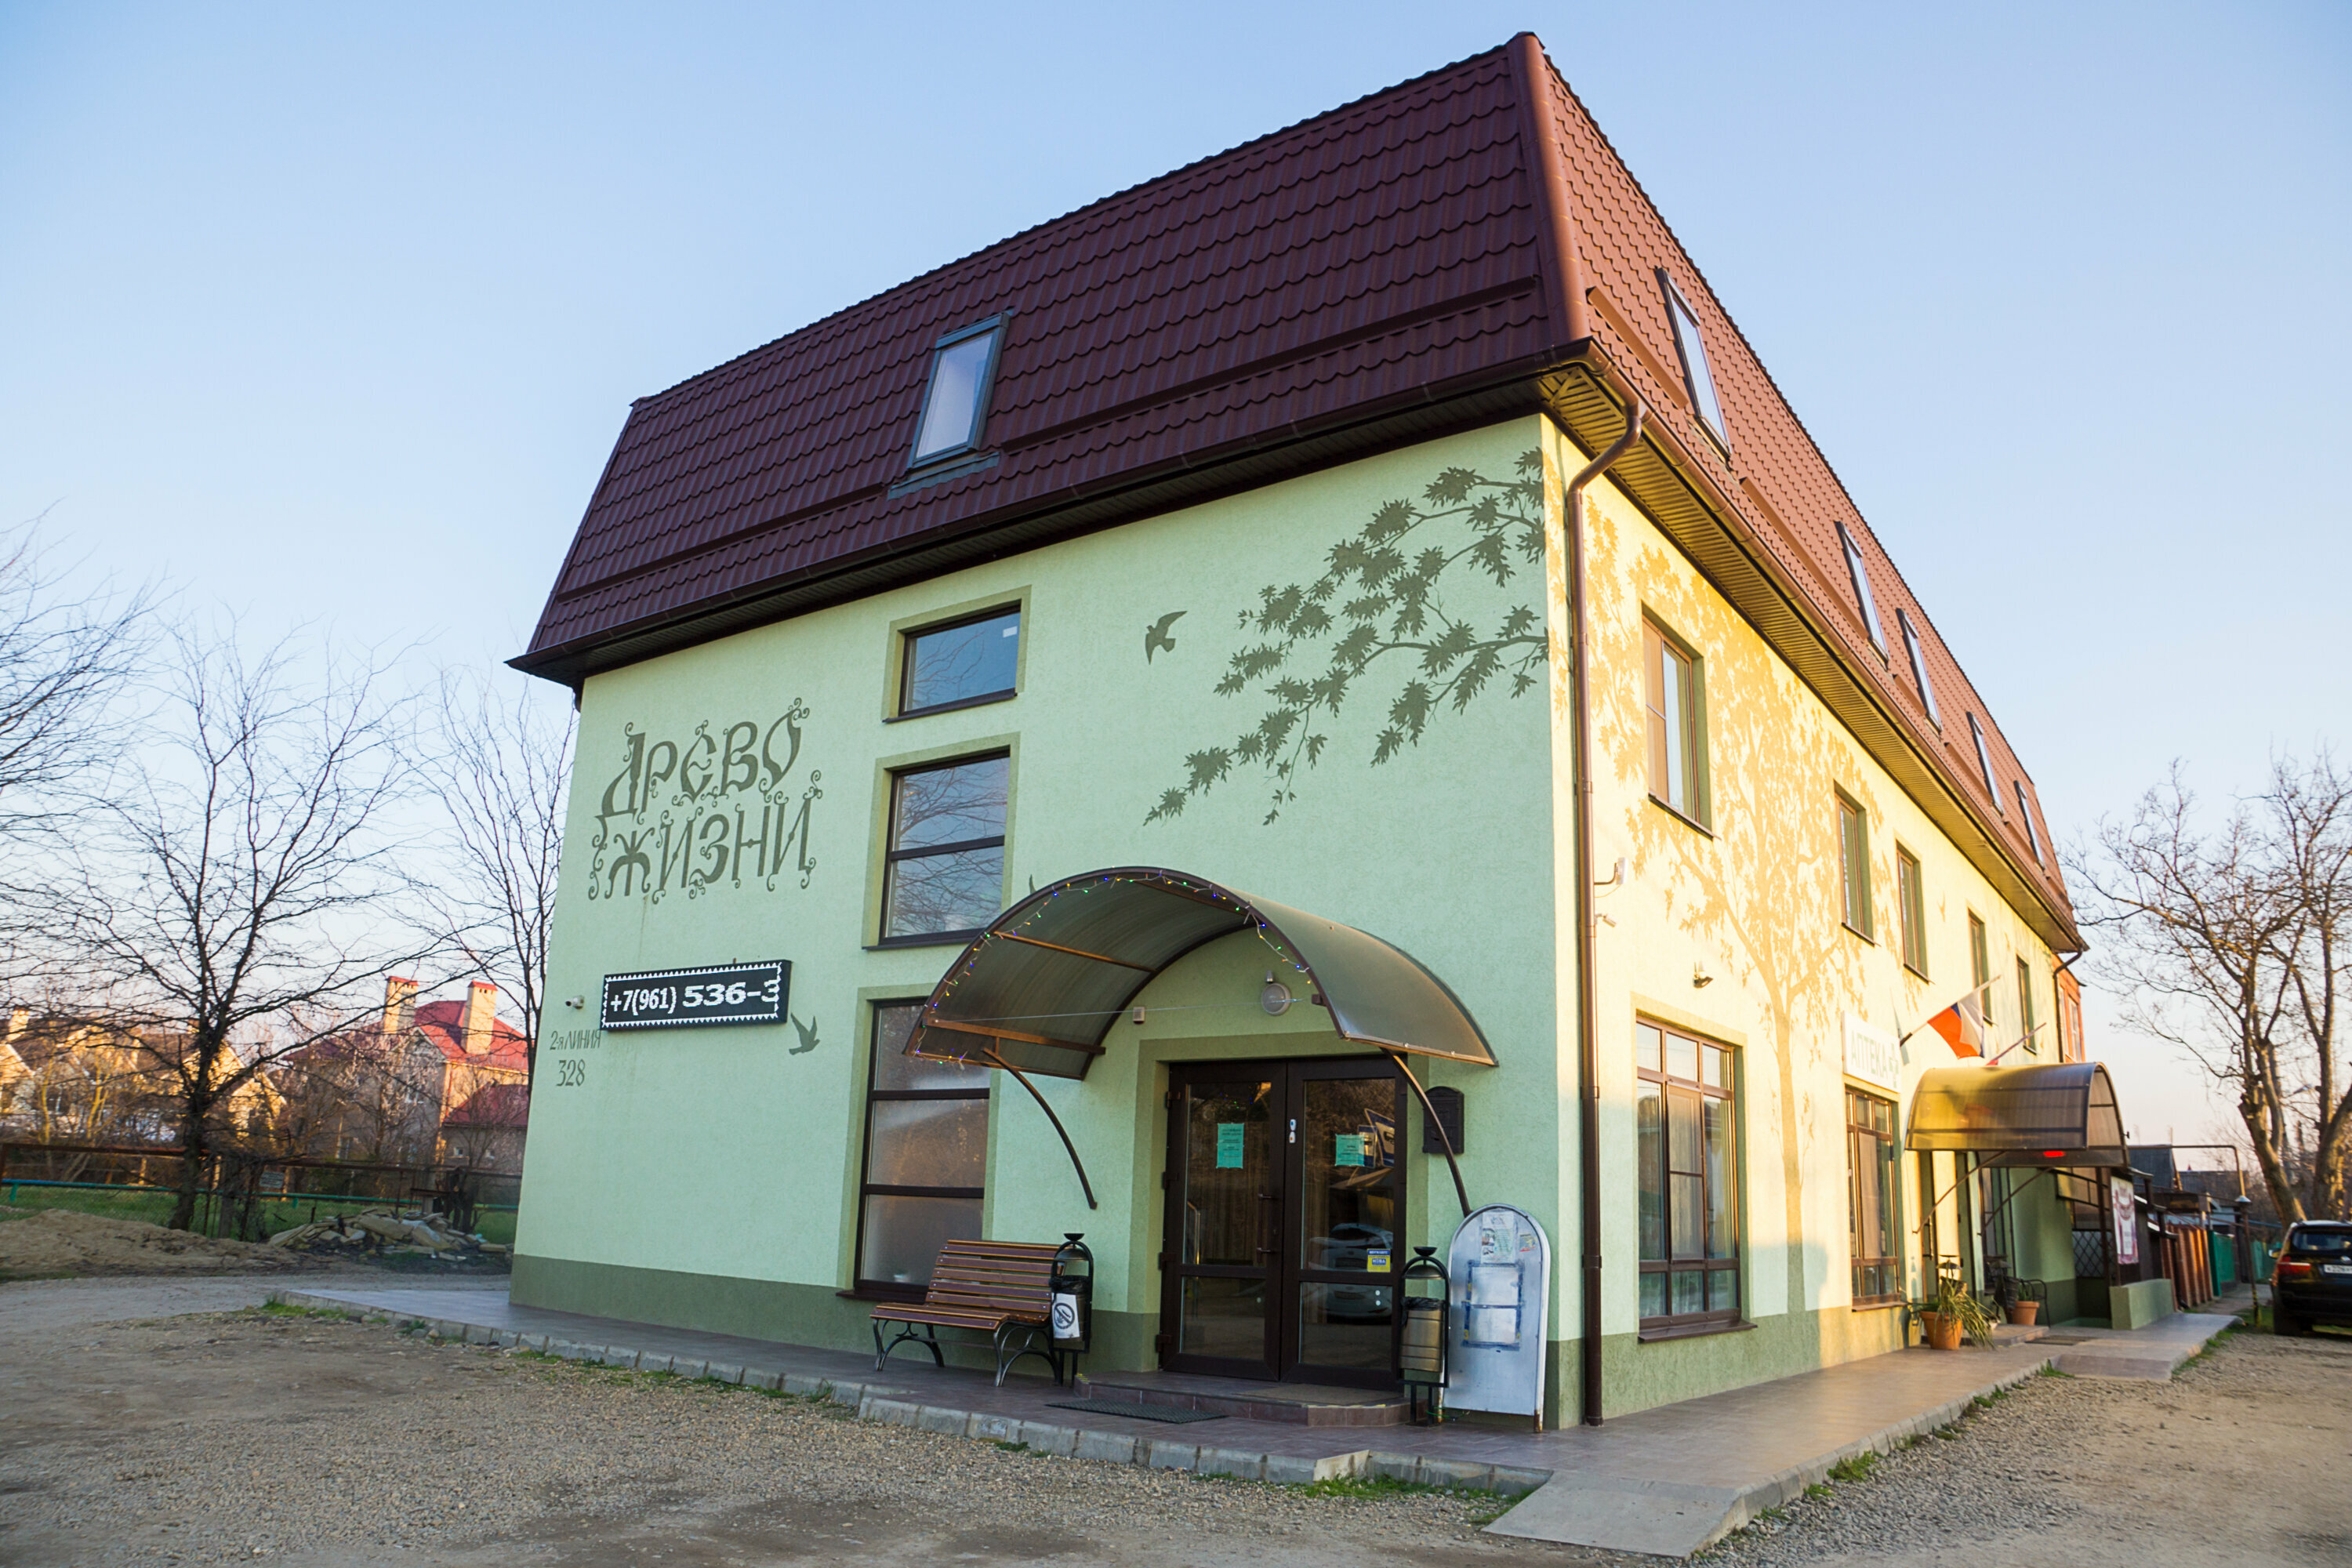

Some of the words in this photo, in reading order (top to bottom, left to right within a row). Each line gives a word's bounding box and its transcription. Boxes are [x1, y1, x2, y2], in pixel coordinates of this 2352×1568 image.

[594, 697, 810, 826] ДРЕВО
[604, 770, 823, 904] ЖИЗНИ
[610, 986, 677, 1016] +7(961)
[555, 1058, 586, 1087] 328
[1850, 1029, 1889, 1080] АПТЕКА
